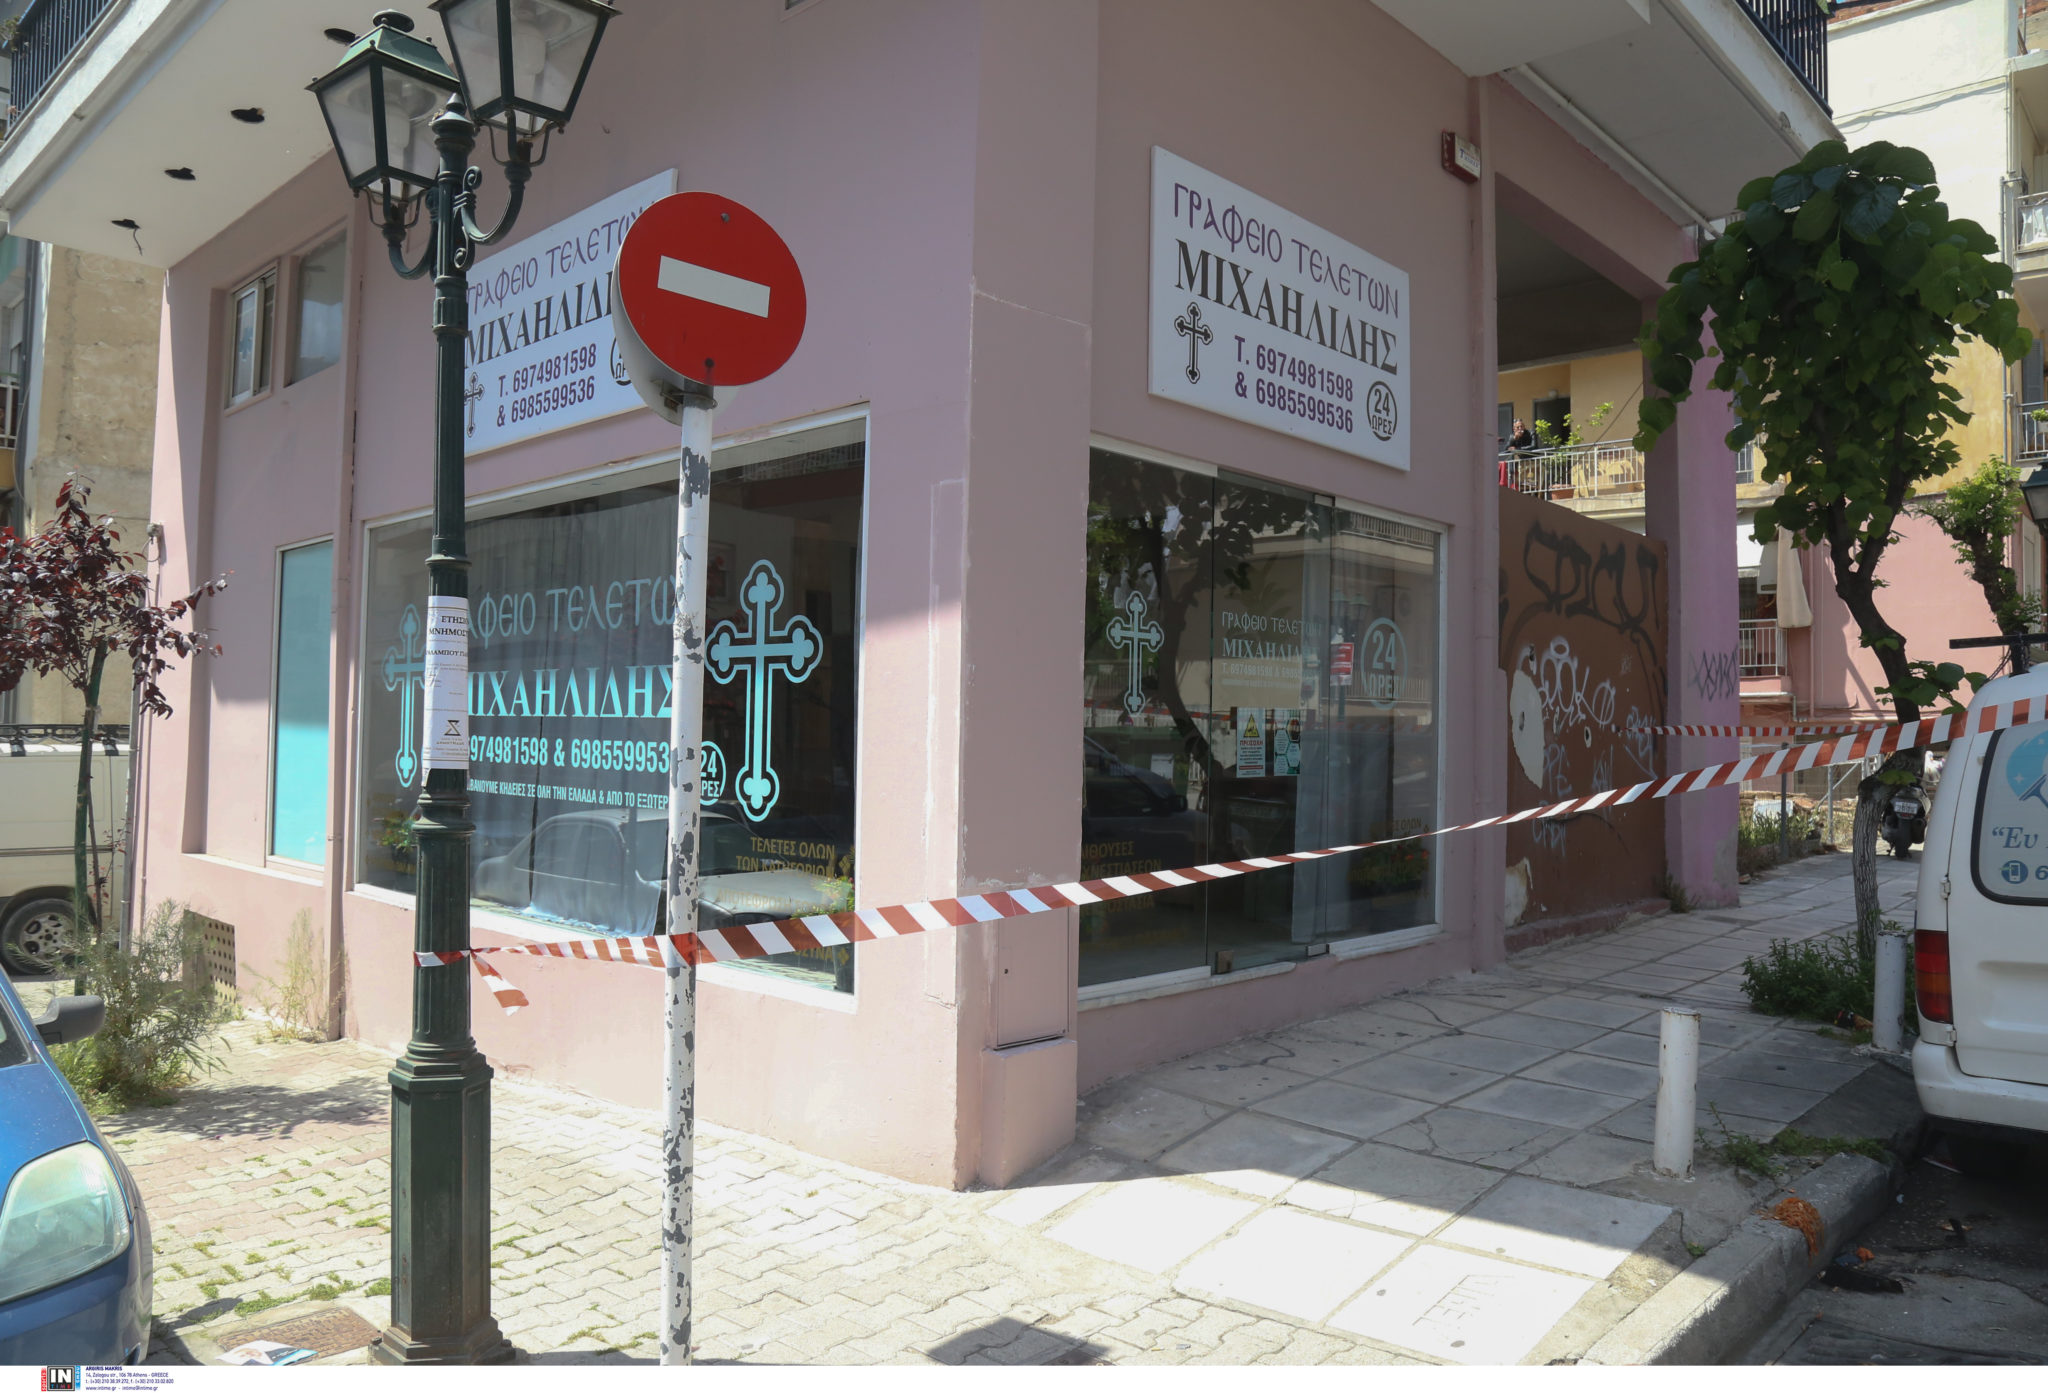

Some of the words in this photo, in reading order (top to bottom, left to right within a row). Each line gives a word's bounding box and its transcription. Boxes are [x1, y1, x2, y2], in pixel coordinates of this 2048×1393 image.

[465, 257, 538, 315] ΓΡΑΦΕΙΟ
[545, 201, 656, 278] ΤΕΛΕΤΩ
[1174, 182, 1282, 263] ΓΡΑΦΕΙΟ
[1291, 238, 1399, 319] ΤΕΛΕΤΩΝ
[1174, 238, 1398, 376] ΜΙΧΑΗΛΙΔΗΣ
[513, 343, 597, 393] 6974981598
[1256, 344, 1353, 402] 6974981598
[496, 404, 505, 427] &
[511, 375, 596, 425] 6985599536
[1235, 371, 1248, 399] &
[1256, 378, 1353, 434] 6985599536
[1373, 388, 1391, 417] 24
[1371, 415, 1394, 437] ΩΡΕΣ
[467, 591, 536, 650] ΦΕΙΟ
[1221, 611, 1267, 633] ΓΡΑΦΕΙΟ
[1373, 630, 1396, 671] 24
[468, 734, 548, 767] 974981598
[553, 738, 565, 767] &
[499, 781, 526, 797] ΚΗΔΕΙΕΣ
[527, 784, 536, 797] ΣΕ
[537, 784, 551, 799] ΟΛΗ
[552, 786, 567, 801] ΤΗΝ
[568, 787, 597, 804] ΕΛΛΑΔΑ
[599, 790, 604, 804] &
[606, 790, 623, 806] ΑΠΟ
[624, 792, 635, 808] ΤΟ
[736, 855, 759, 873] ΤΩΝ
[750, 836, 797, 857] ΤΕΛΕΤΕΣ
[799, 841, 836, 859] ΟΛΩΝ
